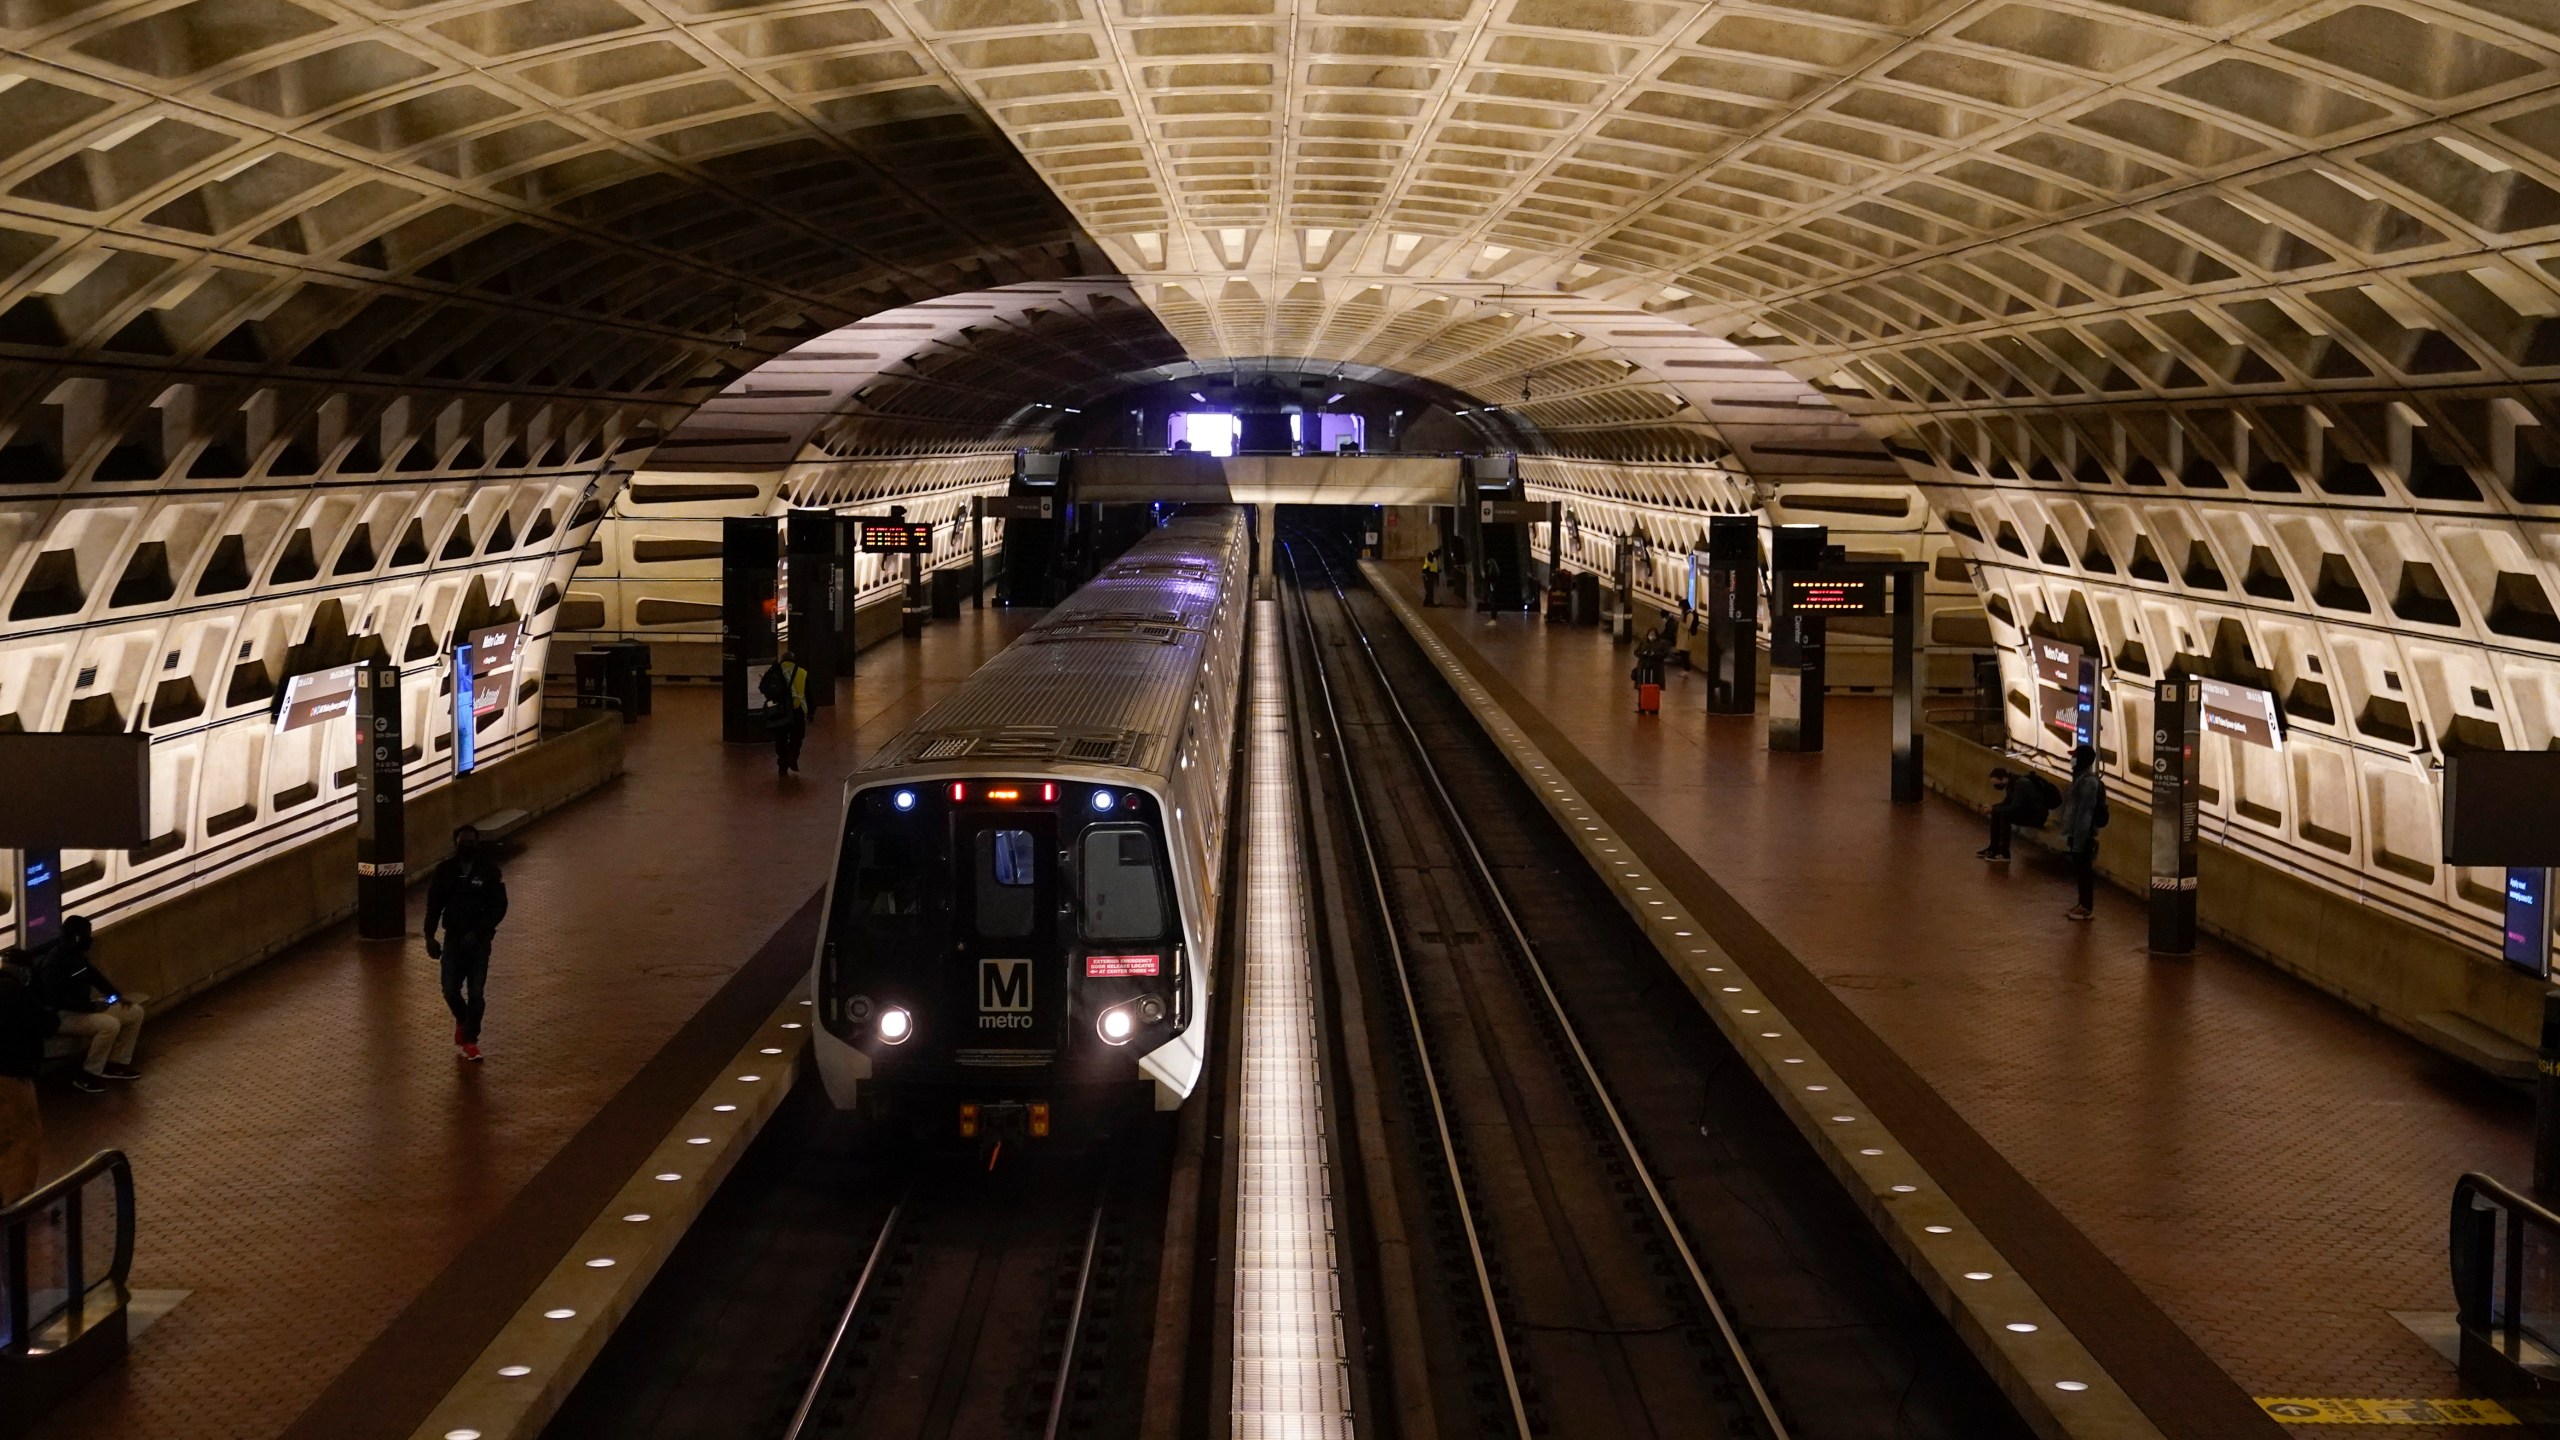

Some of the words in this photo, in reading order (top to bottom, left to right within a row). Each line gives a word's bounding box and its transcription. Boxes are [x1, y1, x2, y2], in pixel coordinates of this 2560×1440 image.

[1728, 593, 1736, 619] Center
[482, 634, 494, 649] Metro
[493, 632, 507, 647] Center
[1794, 615, 1802, 644] Center
[983, 962, 1029, 1008] M
[979, 1013, 1033, 1029] metro
